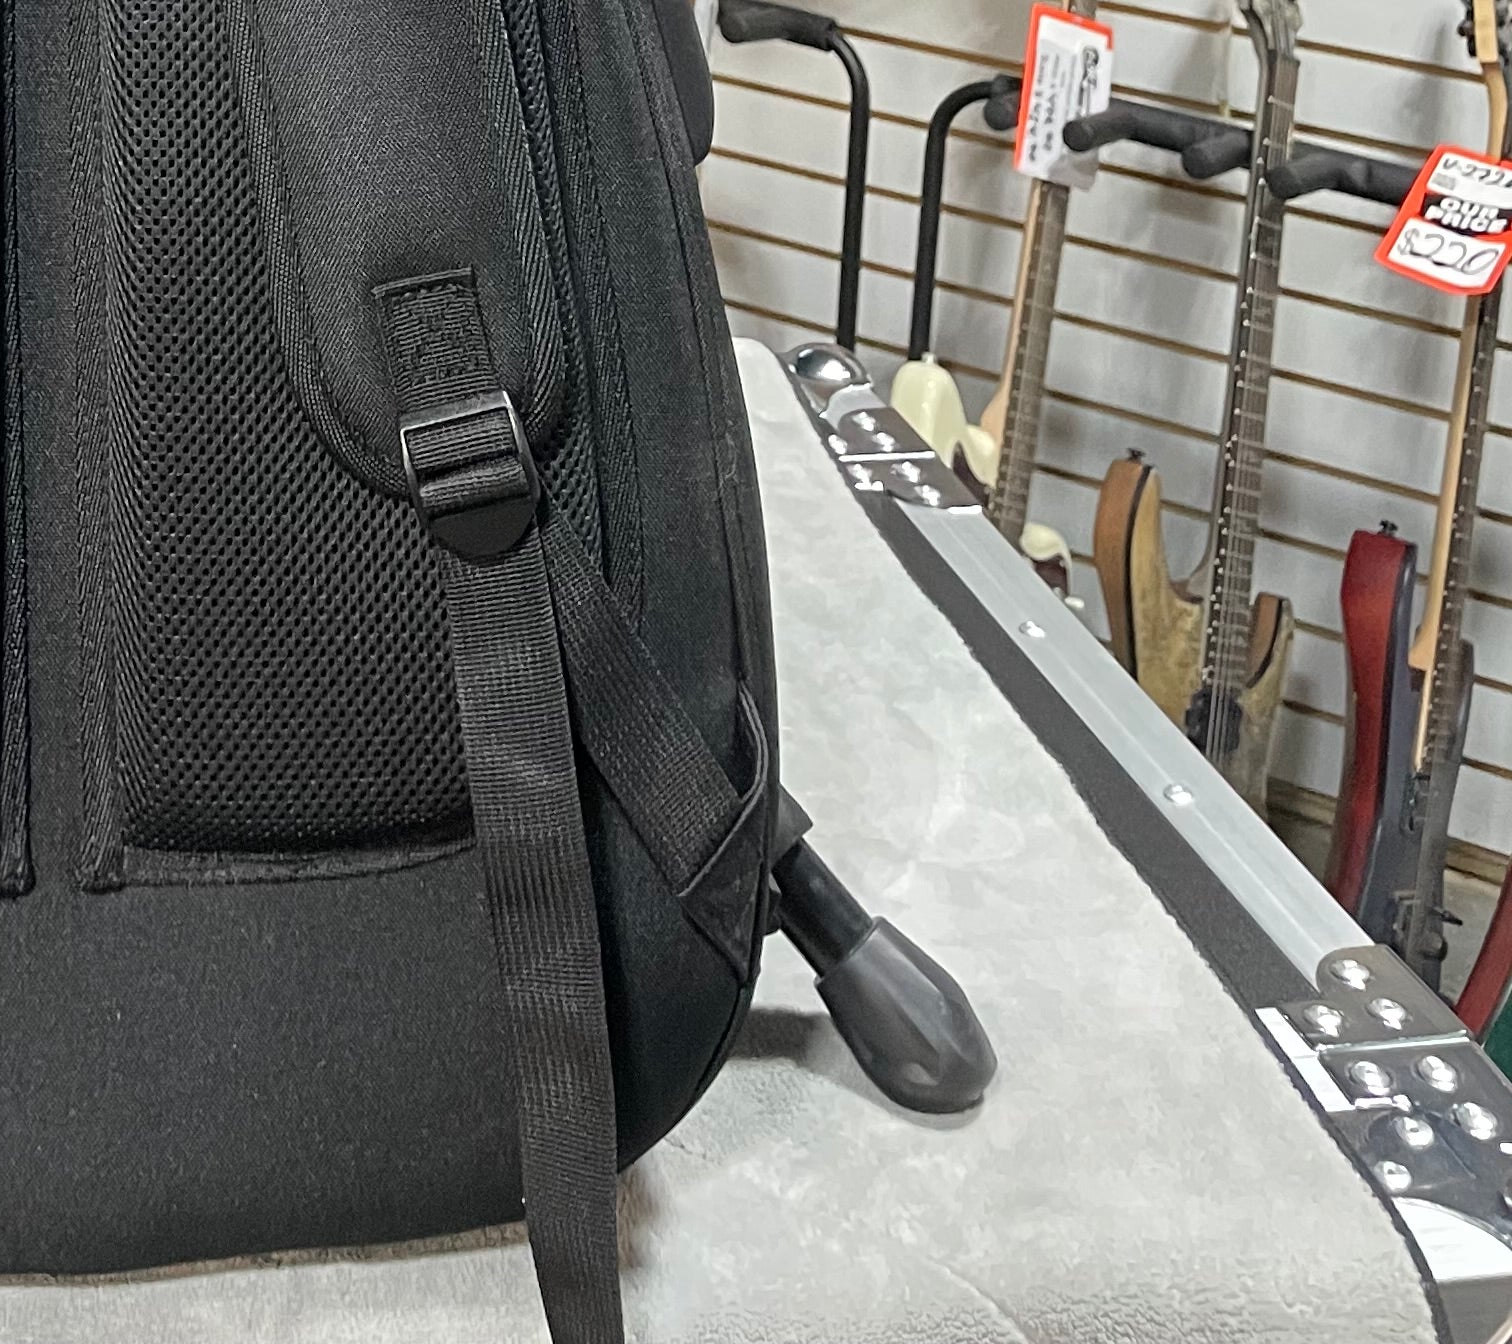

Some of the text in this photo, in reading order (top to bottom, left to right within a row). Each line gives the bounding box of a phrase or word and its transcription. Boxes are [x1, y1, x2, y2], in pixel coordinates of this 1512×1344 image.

[1424, 204, 1508, 234] PRICE
[1439, 197, 1500, 220] OUR
[1397, 228, 1500, 275] $220
